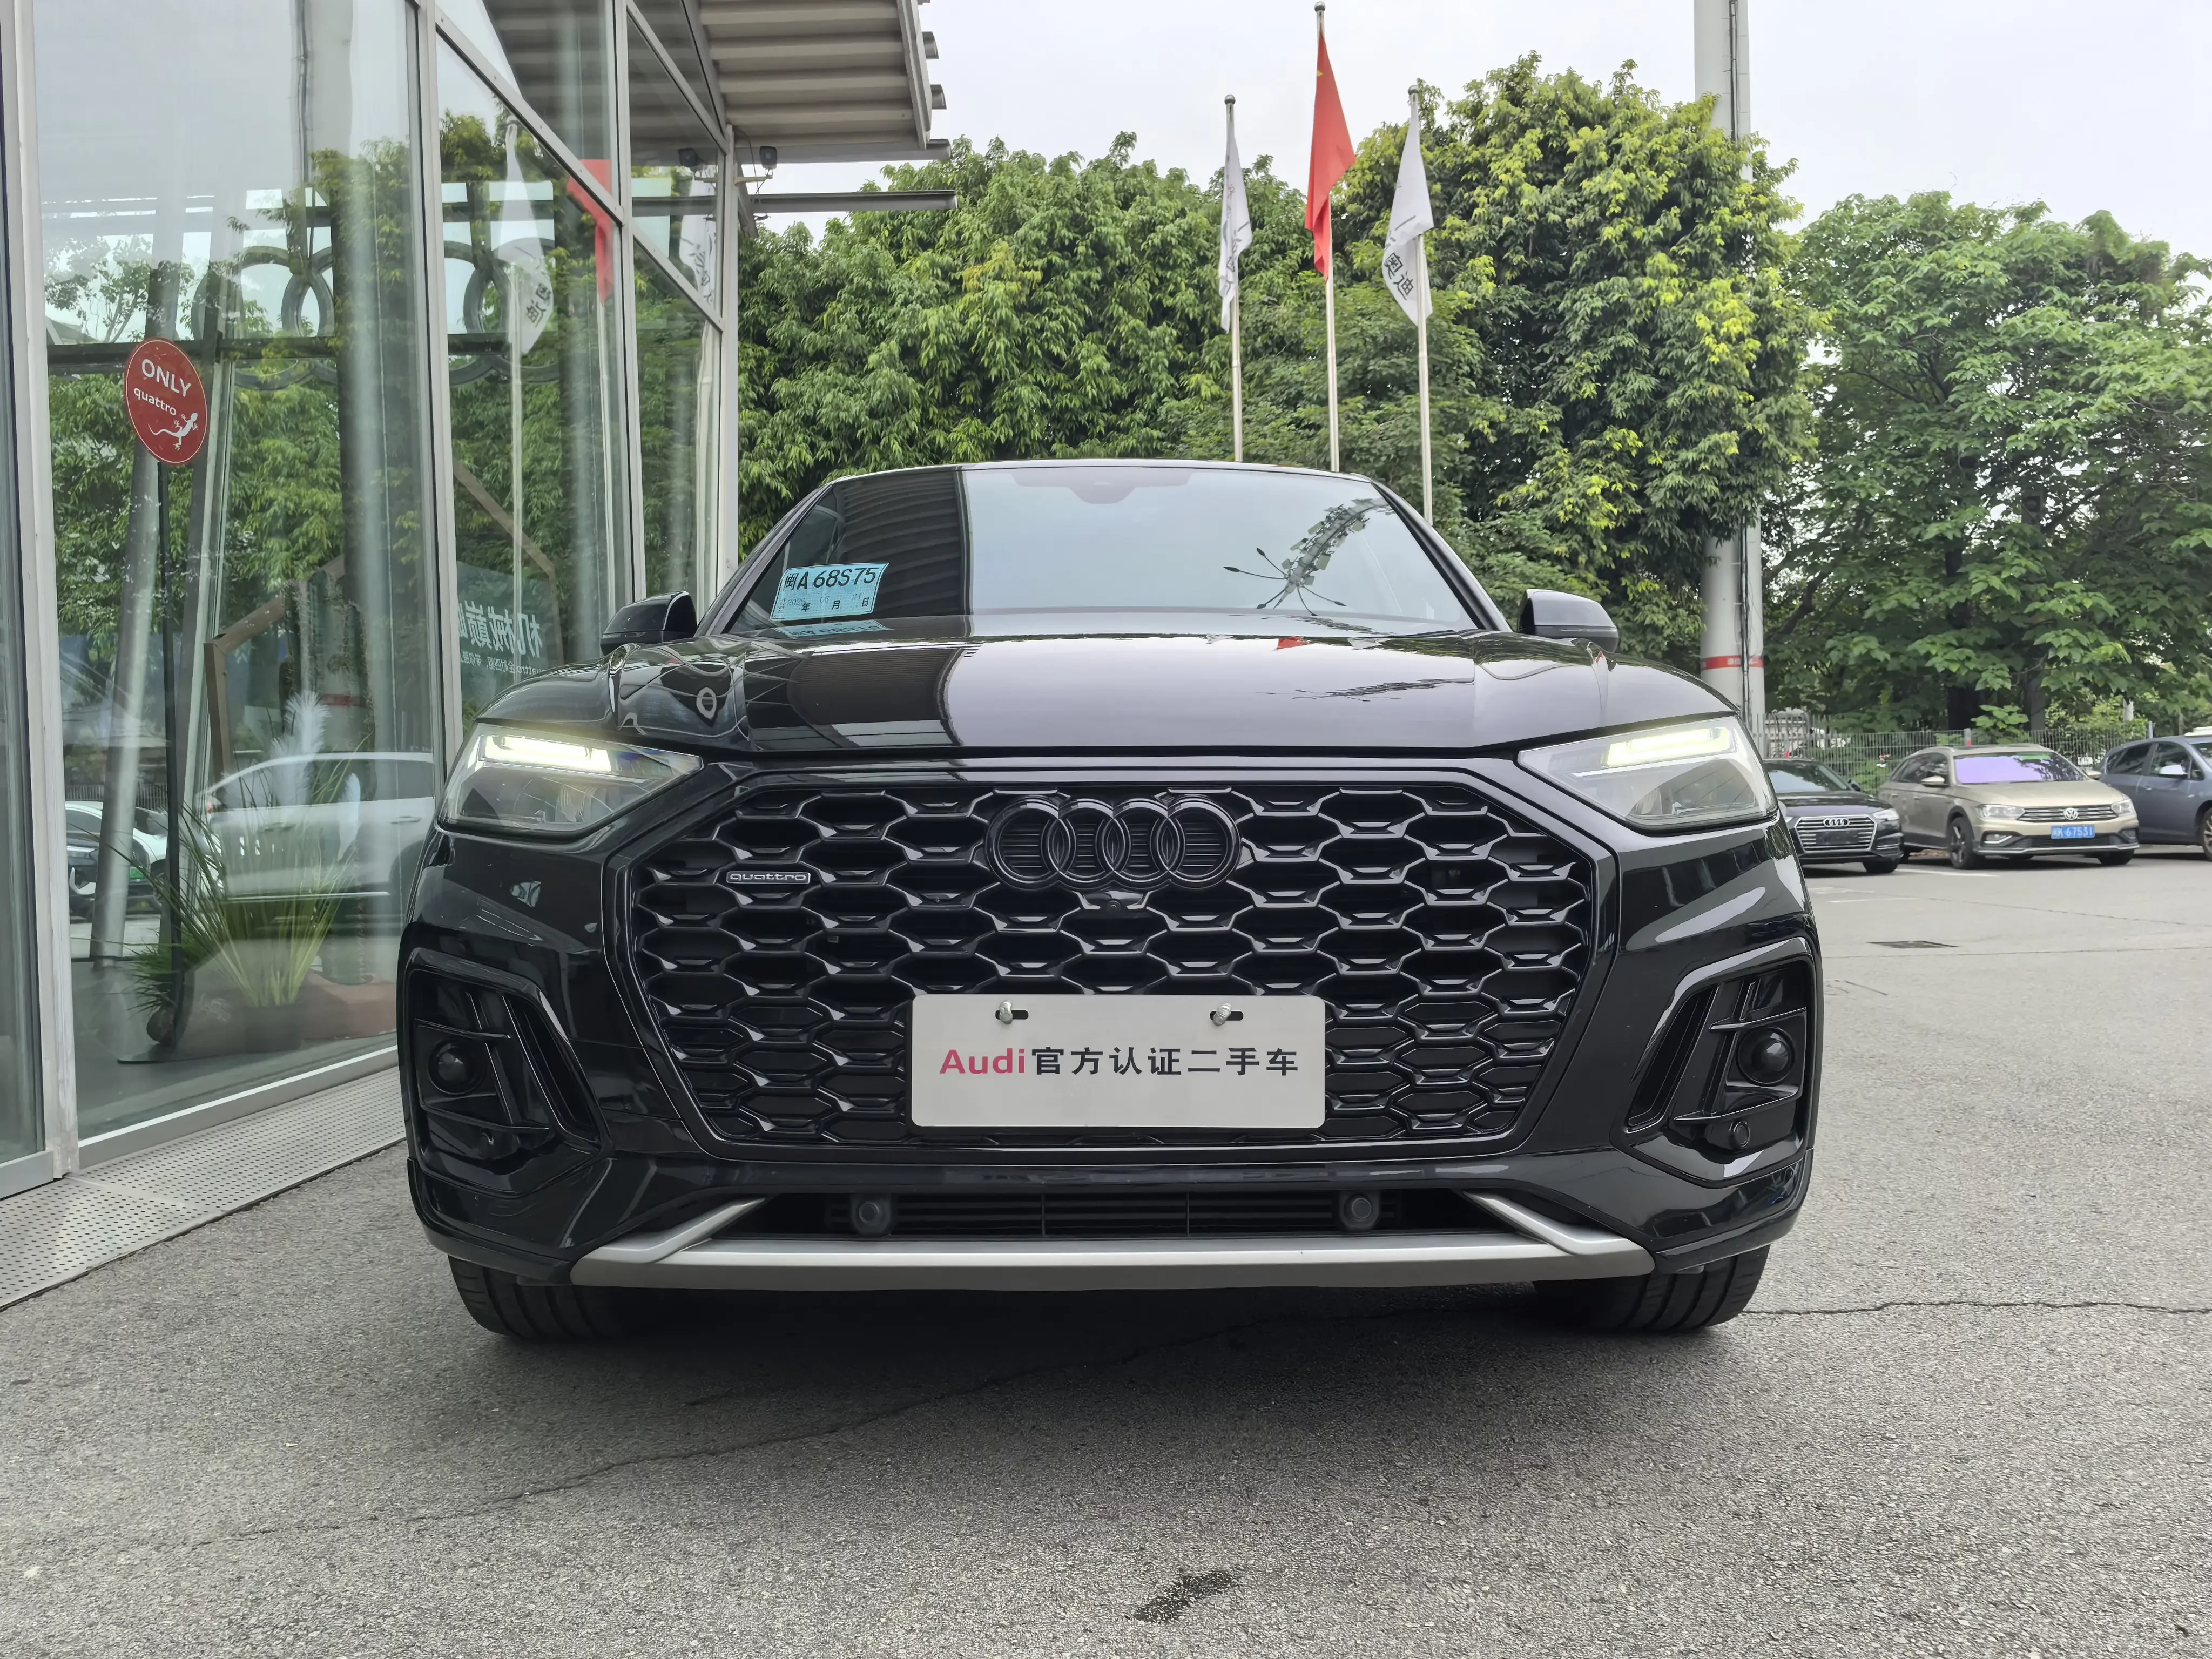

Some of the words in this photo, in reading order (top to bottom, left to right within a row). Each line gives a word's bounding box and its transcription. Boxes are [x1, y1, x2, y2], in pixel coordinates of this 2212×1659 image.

[1384, 252, 1413, 301] 奥迪
[141, 359, 192, 397] ONLY
[134, 387, 177, 416] quattro
[730, 873, 806, 881] quattro
